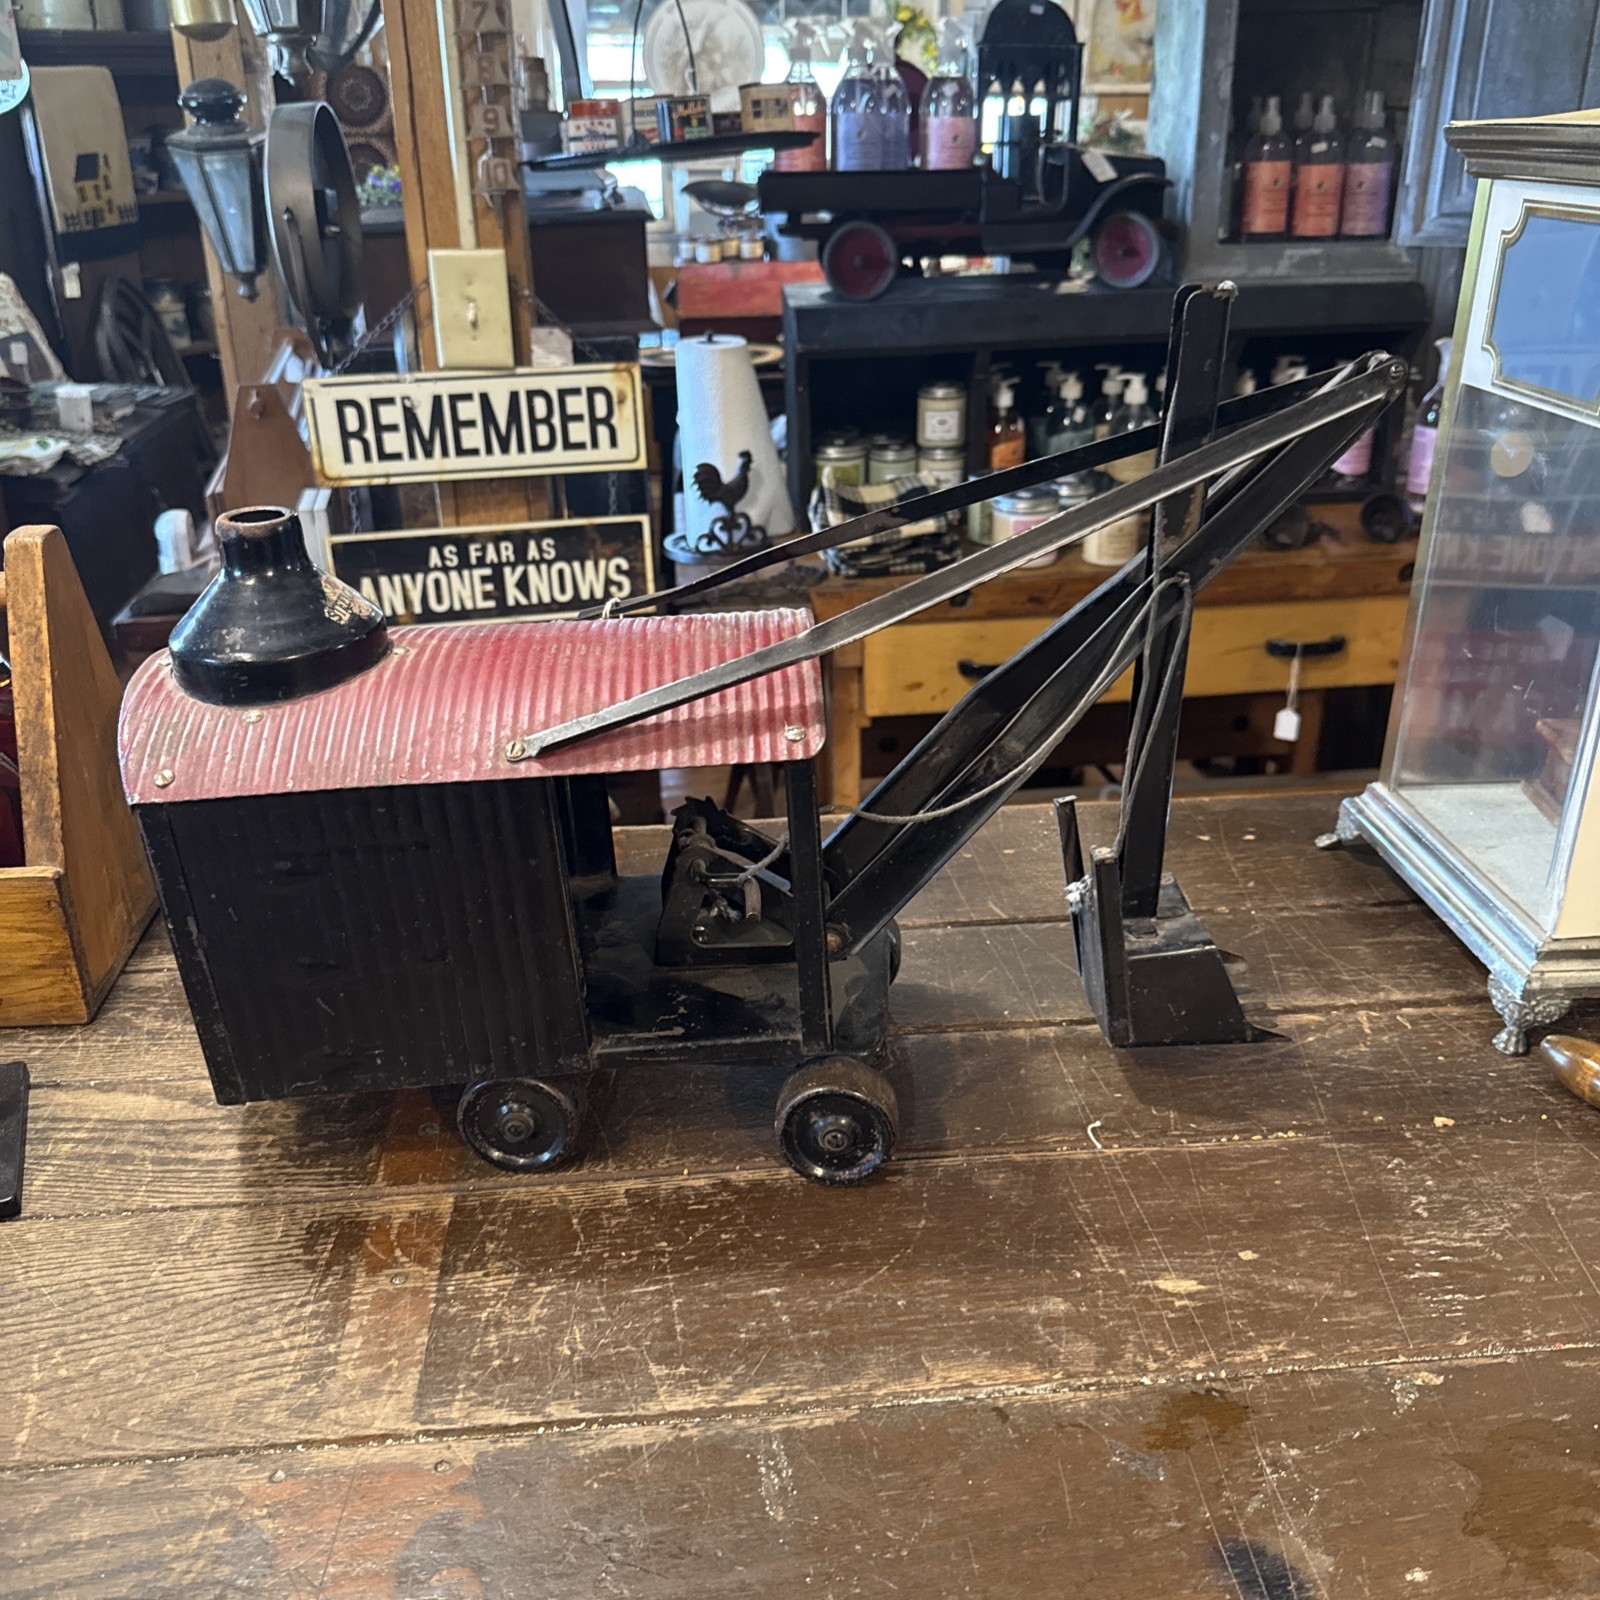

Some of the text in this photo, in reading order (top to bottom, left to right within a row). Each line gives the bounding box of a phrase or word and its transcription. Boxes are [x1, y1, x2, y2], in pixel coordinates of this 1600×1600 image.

[483, 107, 499, 133] 9
[336, 386, 618, 465] REMEMBER
[428, 538, 556, 569] AS FAR AS
[360, 556, 632, 618] ANYONE KNOWS
